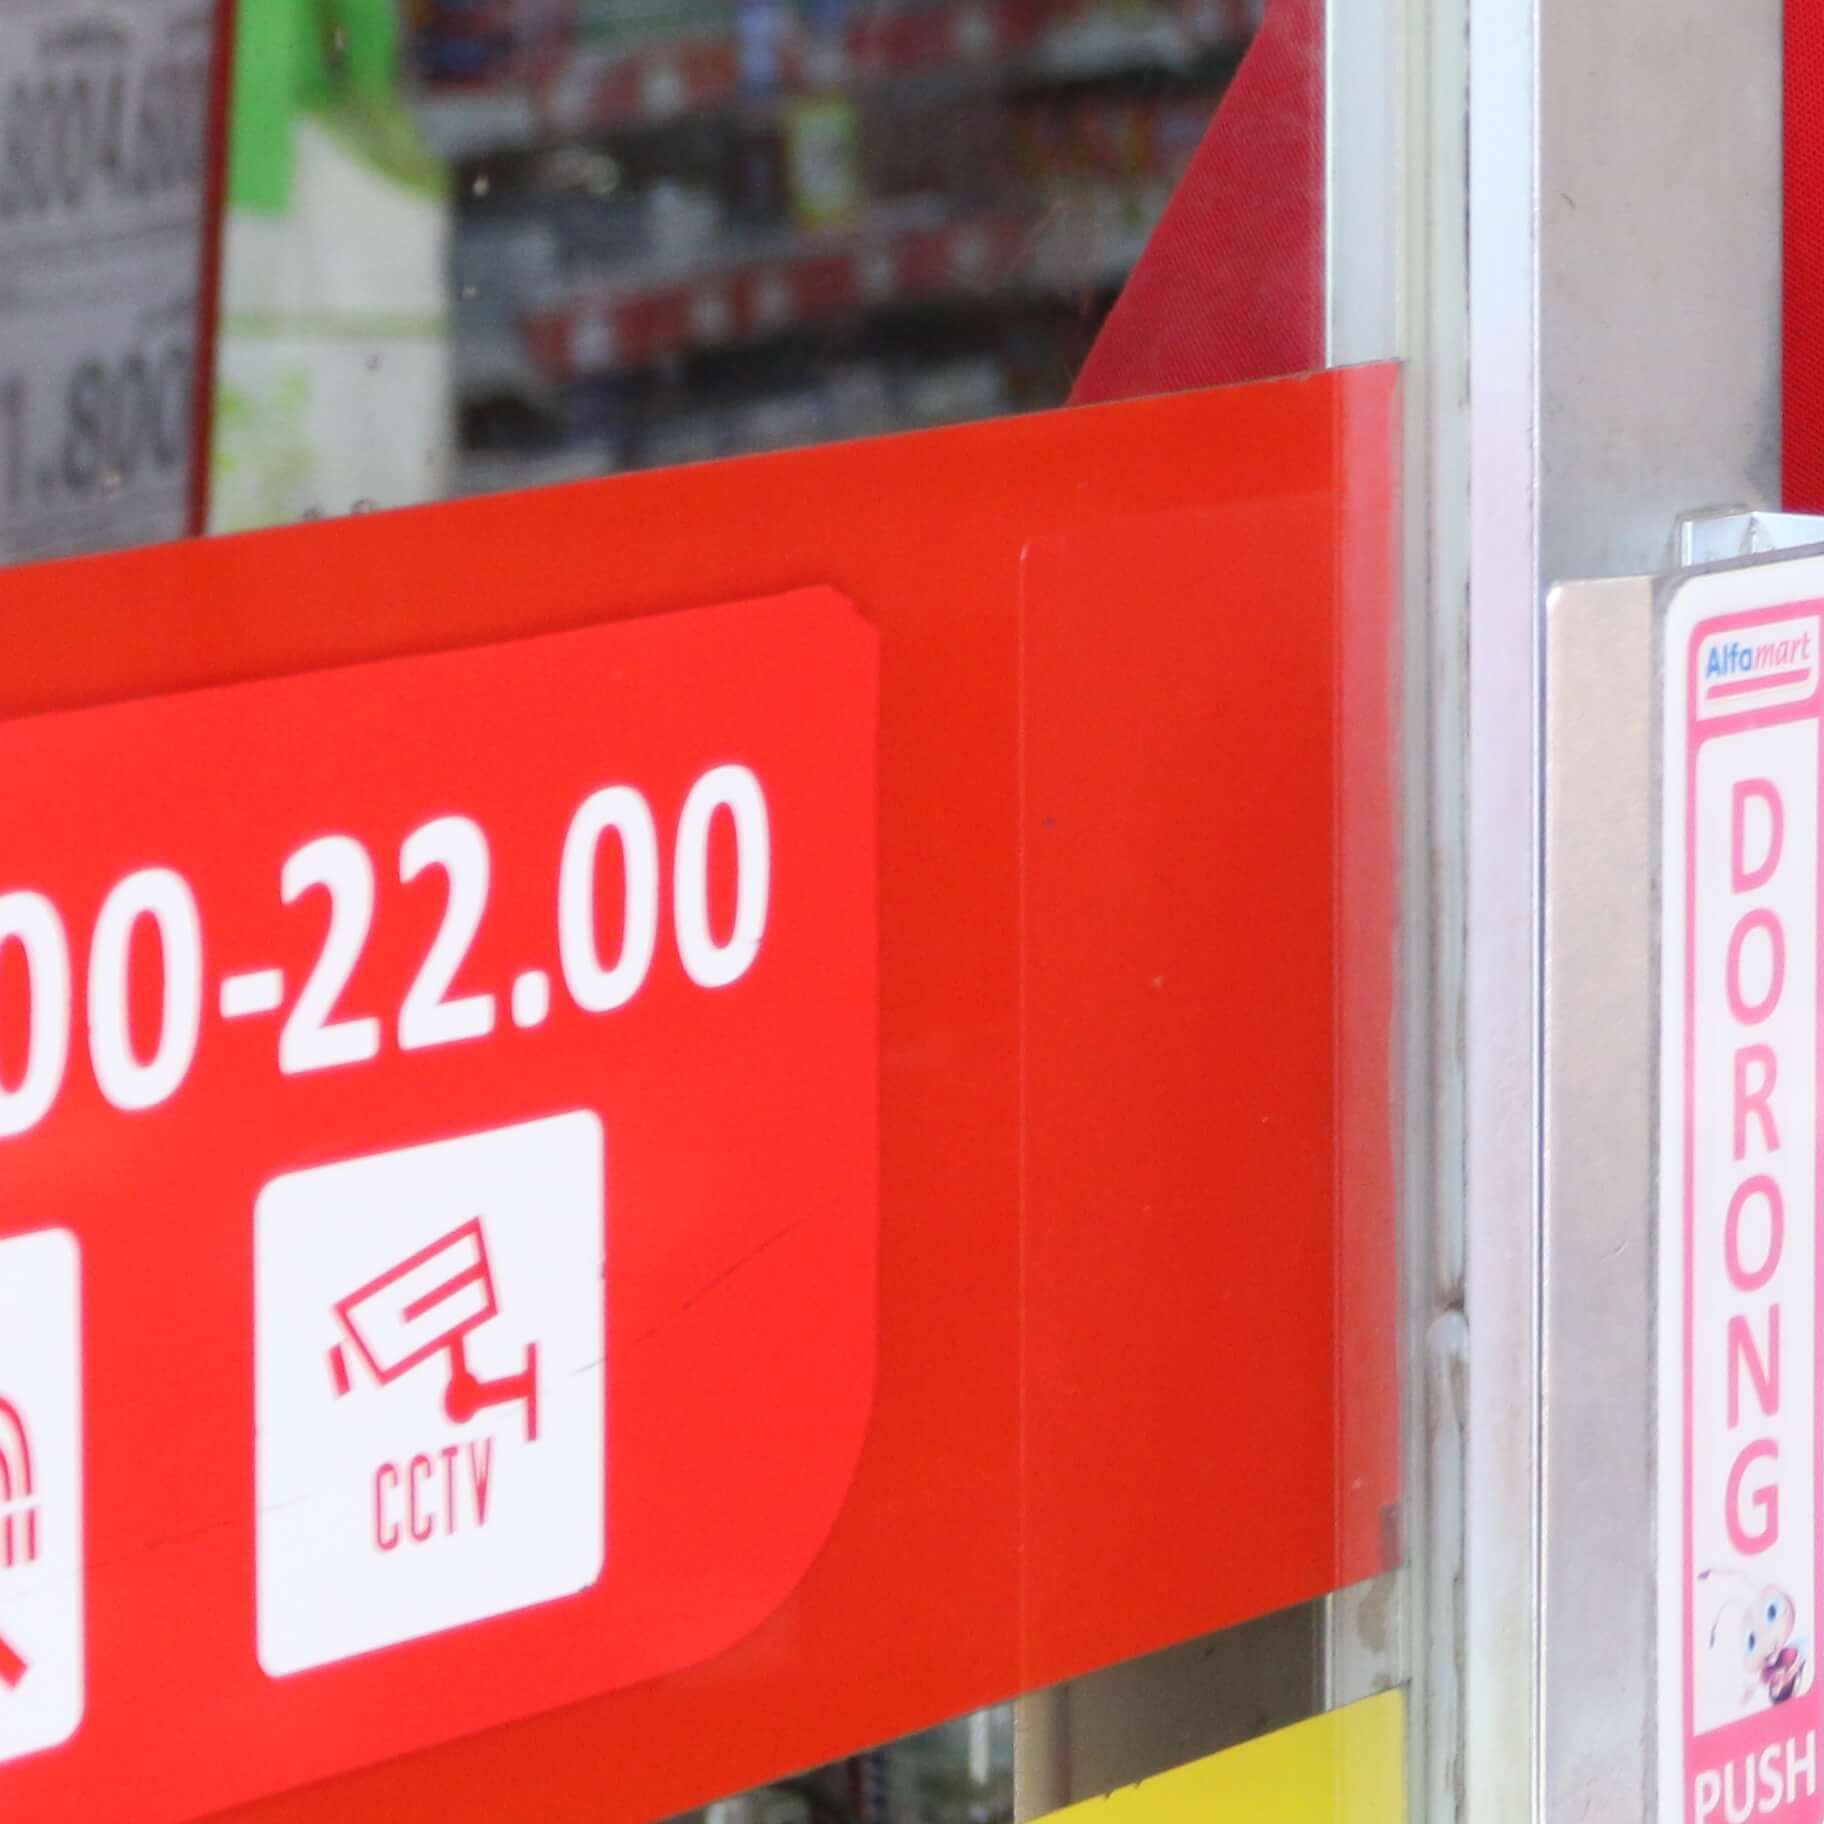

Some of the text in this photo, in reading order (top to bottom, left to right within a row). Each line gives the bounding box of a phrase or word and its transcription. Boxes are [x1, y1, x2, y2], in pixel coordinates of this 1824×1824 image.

[1705, 632, 1811, 680] Alfamart
[1723, 776, 1786, 1557] DORONG
[376, 1436, 494, 1552] CCTV
[1694, 1728, 1817, 1824] PUSH
